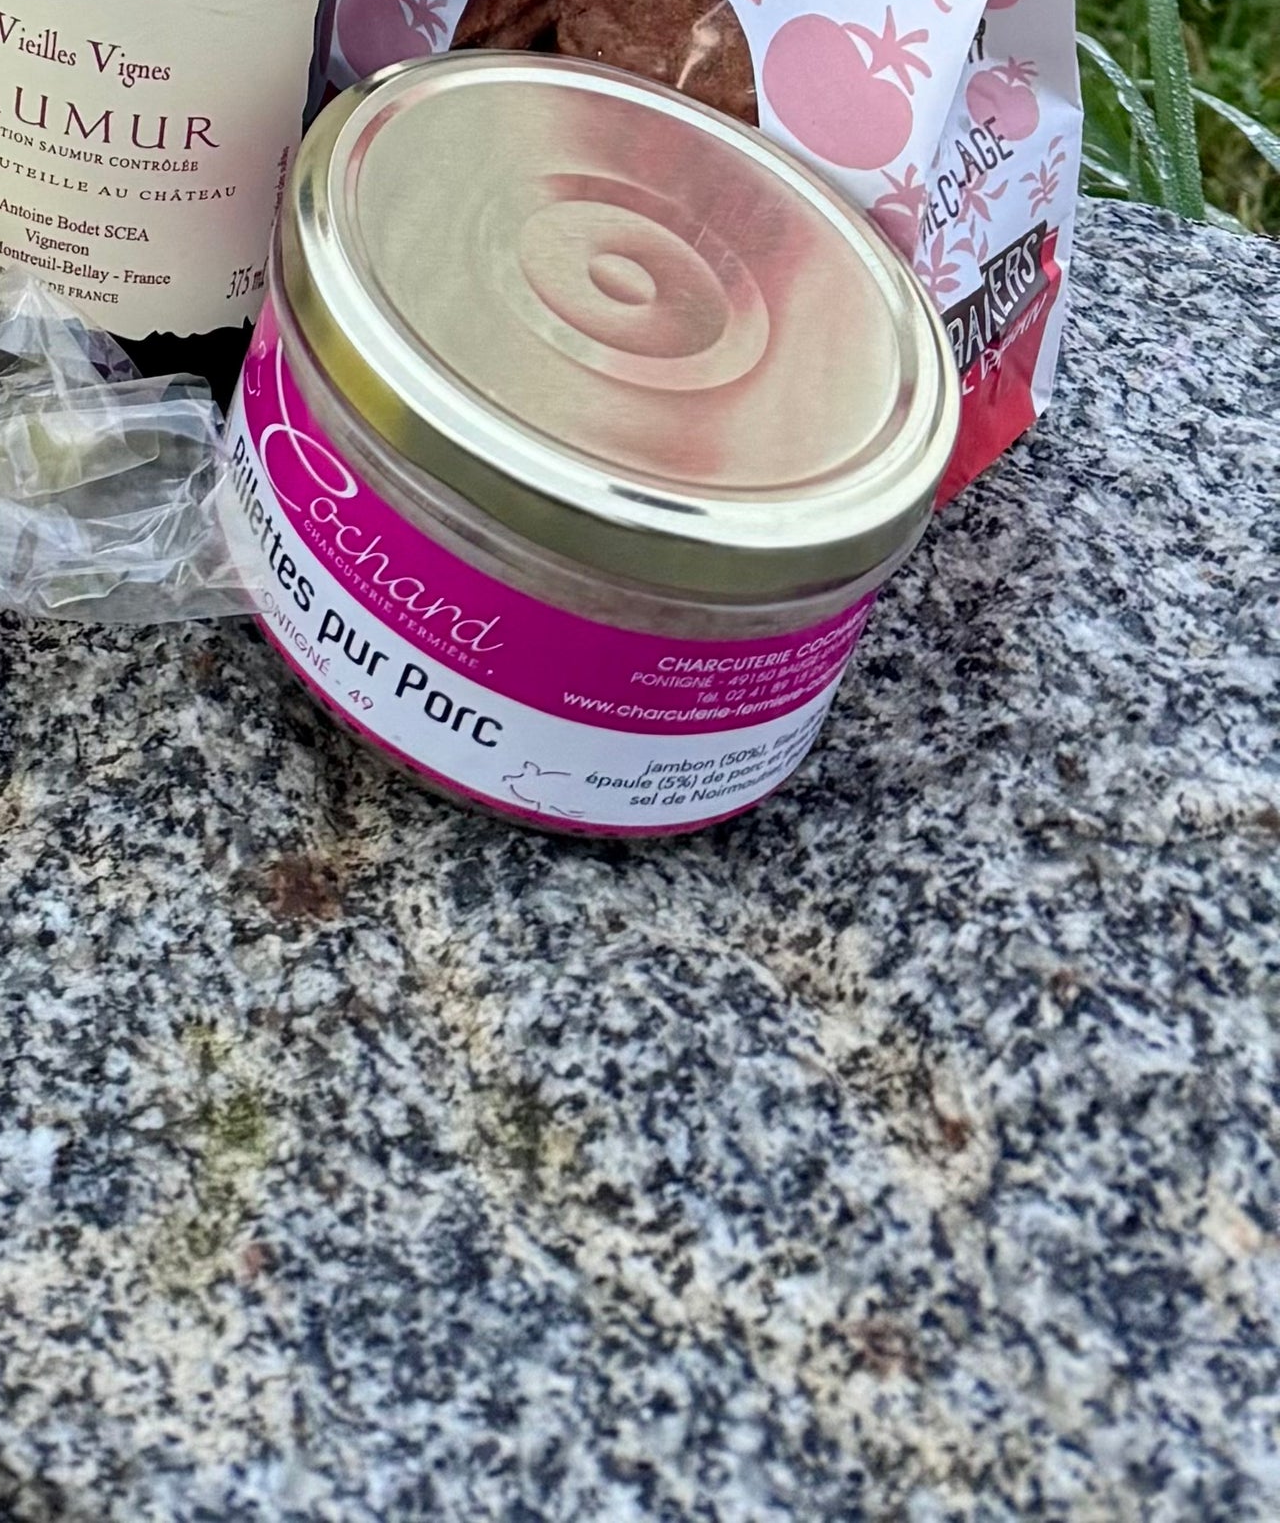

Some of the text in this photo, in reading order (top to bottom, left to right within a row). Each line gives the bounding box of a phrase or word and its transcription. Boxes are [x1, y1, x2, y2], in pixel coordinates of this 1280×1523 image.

[87, 40, 171, 88] Vignes
[39, 140, 104, 166] SAUMUR
[109, 154, 200, 173] CONTRÔLÉE
[98, 185, 129, 200] AU
[140, 184, 237, 202] CHÂTEAU
[24, 228, 89, 256] Vigneron
[57, 216, 100, 237] Bodet
[105, 225, 150, 242] SCEA
[123, 270, 171, 286] France
[226, 264, 253, 299] 375
[68, 286, 119, 304] FRANCE
[303, 519, 393, 614] CHARCUTERIE
[232, 435, 503, 748] Rillettes pur Porc
[264, 591, 330, 676] ONTIGNÉ
[348, 689, 374, 710] 49
[657, 649, 792, 673] CHARCUTERIE
[631, 671, 714, 688] PONTIGNÉ
[585, 771, 653, 789] épaule
[658, 775, 698, 790] (5%)
[702, 771, 724, 785] de
[726, 759, 766, 780] porc
[643, 759, 714, 777] jambon
[630, 793, 658, 806] sel
[662, 793, 686, 805] de
